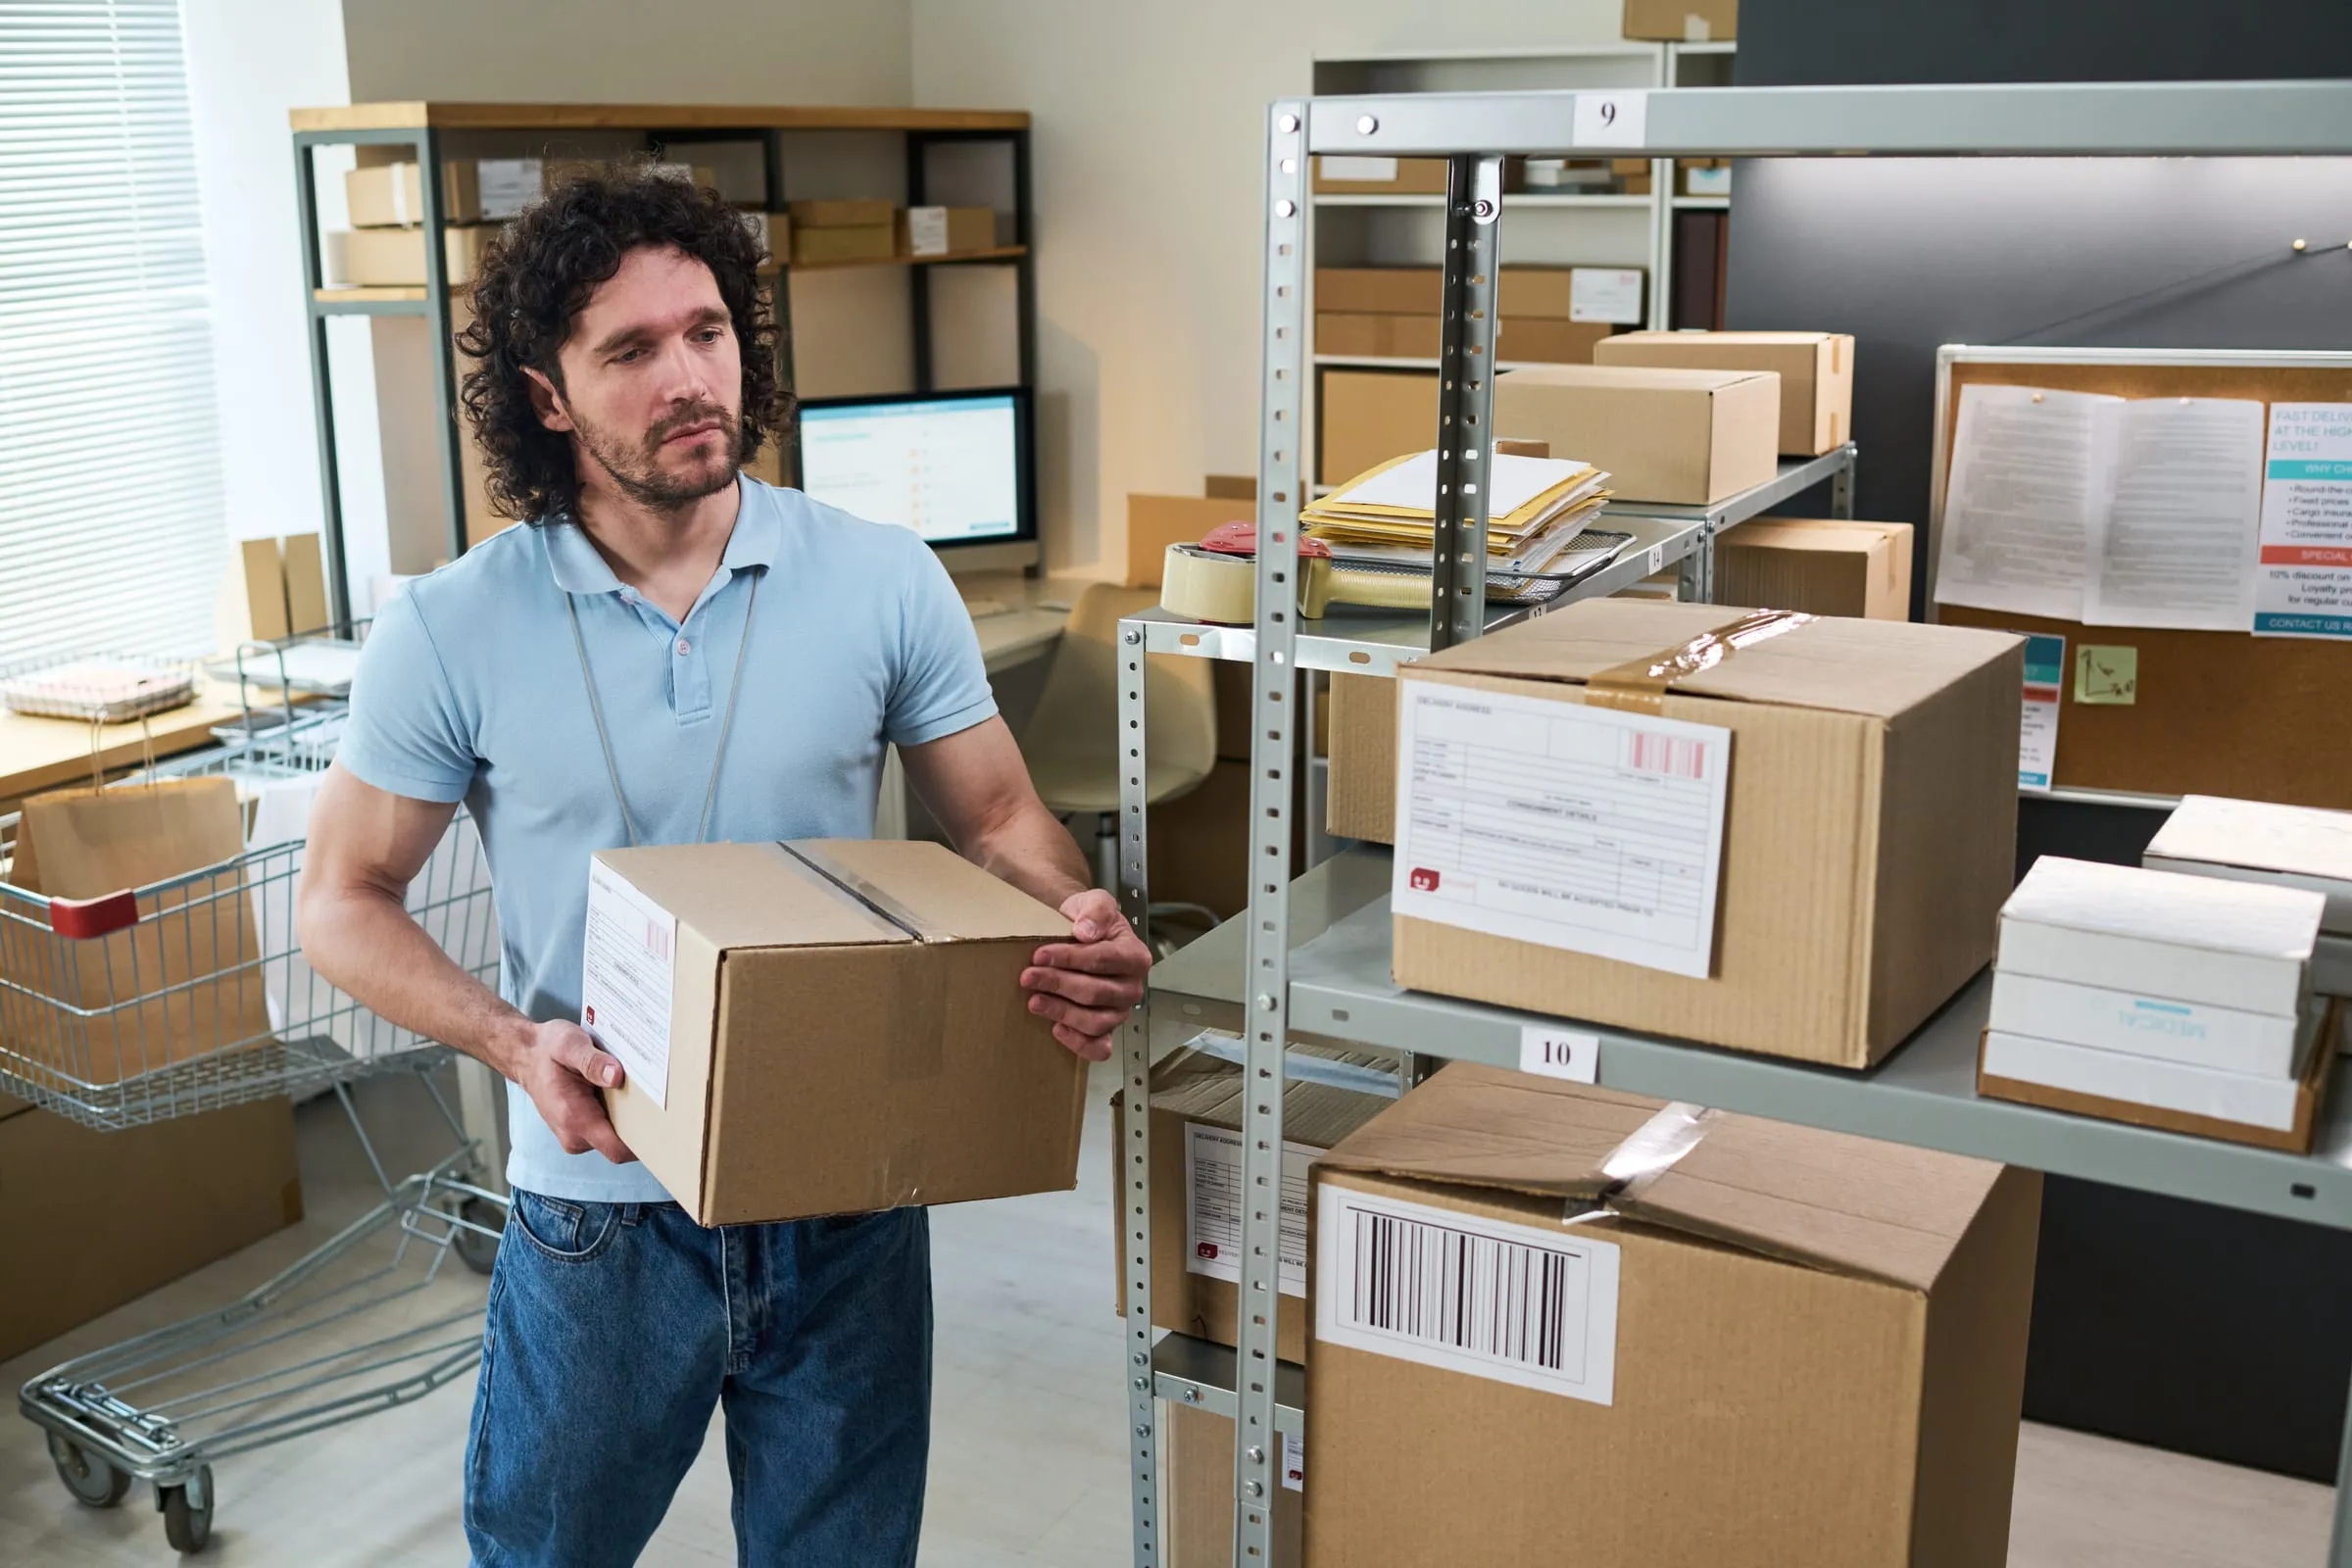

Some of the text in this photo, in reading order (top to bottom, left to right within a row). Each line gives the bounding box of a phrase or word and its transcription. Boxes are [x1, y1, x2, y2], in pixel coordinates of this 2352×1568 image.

[1601, 102, 1616, 128] 9
[2276, 411, 2308, 421] FAST
[2275, 425, 2290, 436] AT
[2295, 425, 2320, 437] THE
[2273, 440, 2319, 452] LEVEL!
[2322, 497, 2349, 507] prices
[2291, 508, 2320, 517] Cargo
[2301, 550, 2348, 562] SPECIAL
[2270, 570, 2289, 579] 10%
[2292, 570, 2334, 580] discount
[2301, 584, 2336, 595] Loyalty
[2288, 595, 2301, 604] for
[2303, 596, 2339, 607] regular
[2269, 617, 2324, 629] CONTACT
[2325, 619, 2340, 630] US
[1544, 1041, 1571, 1066] 10
[1195, 1132, 1219, 1142] DELIVERY
